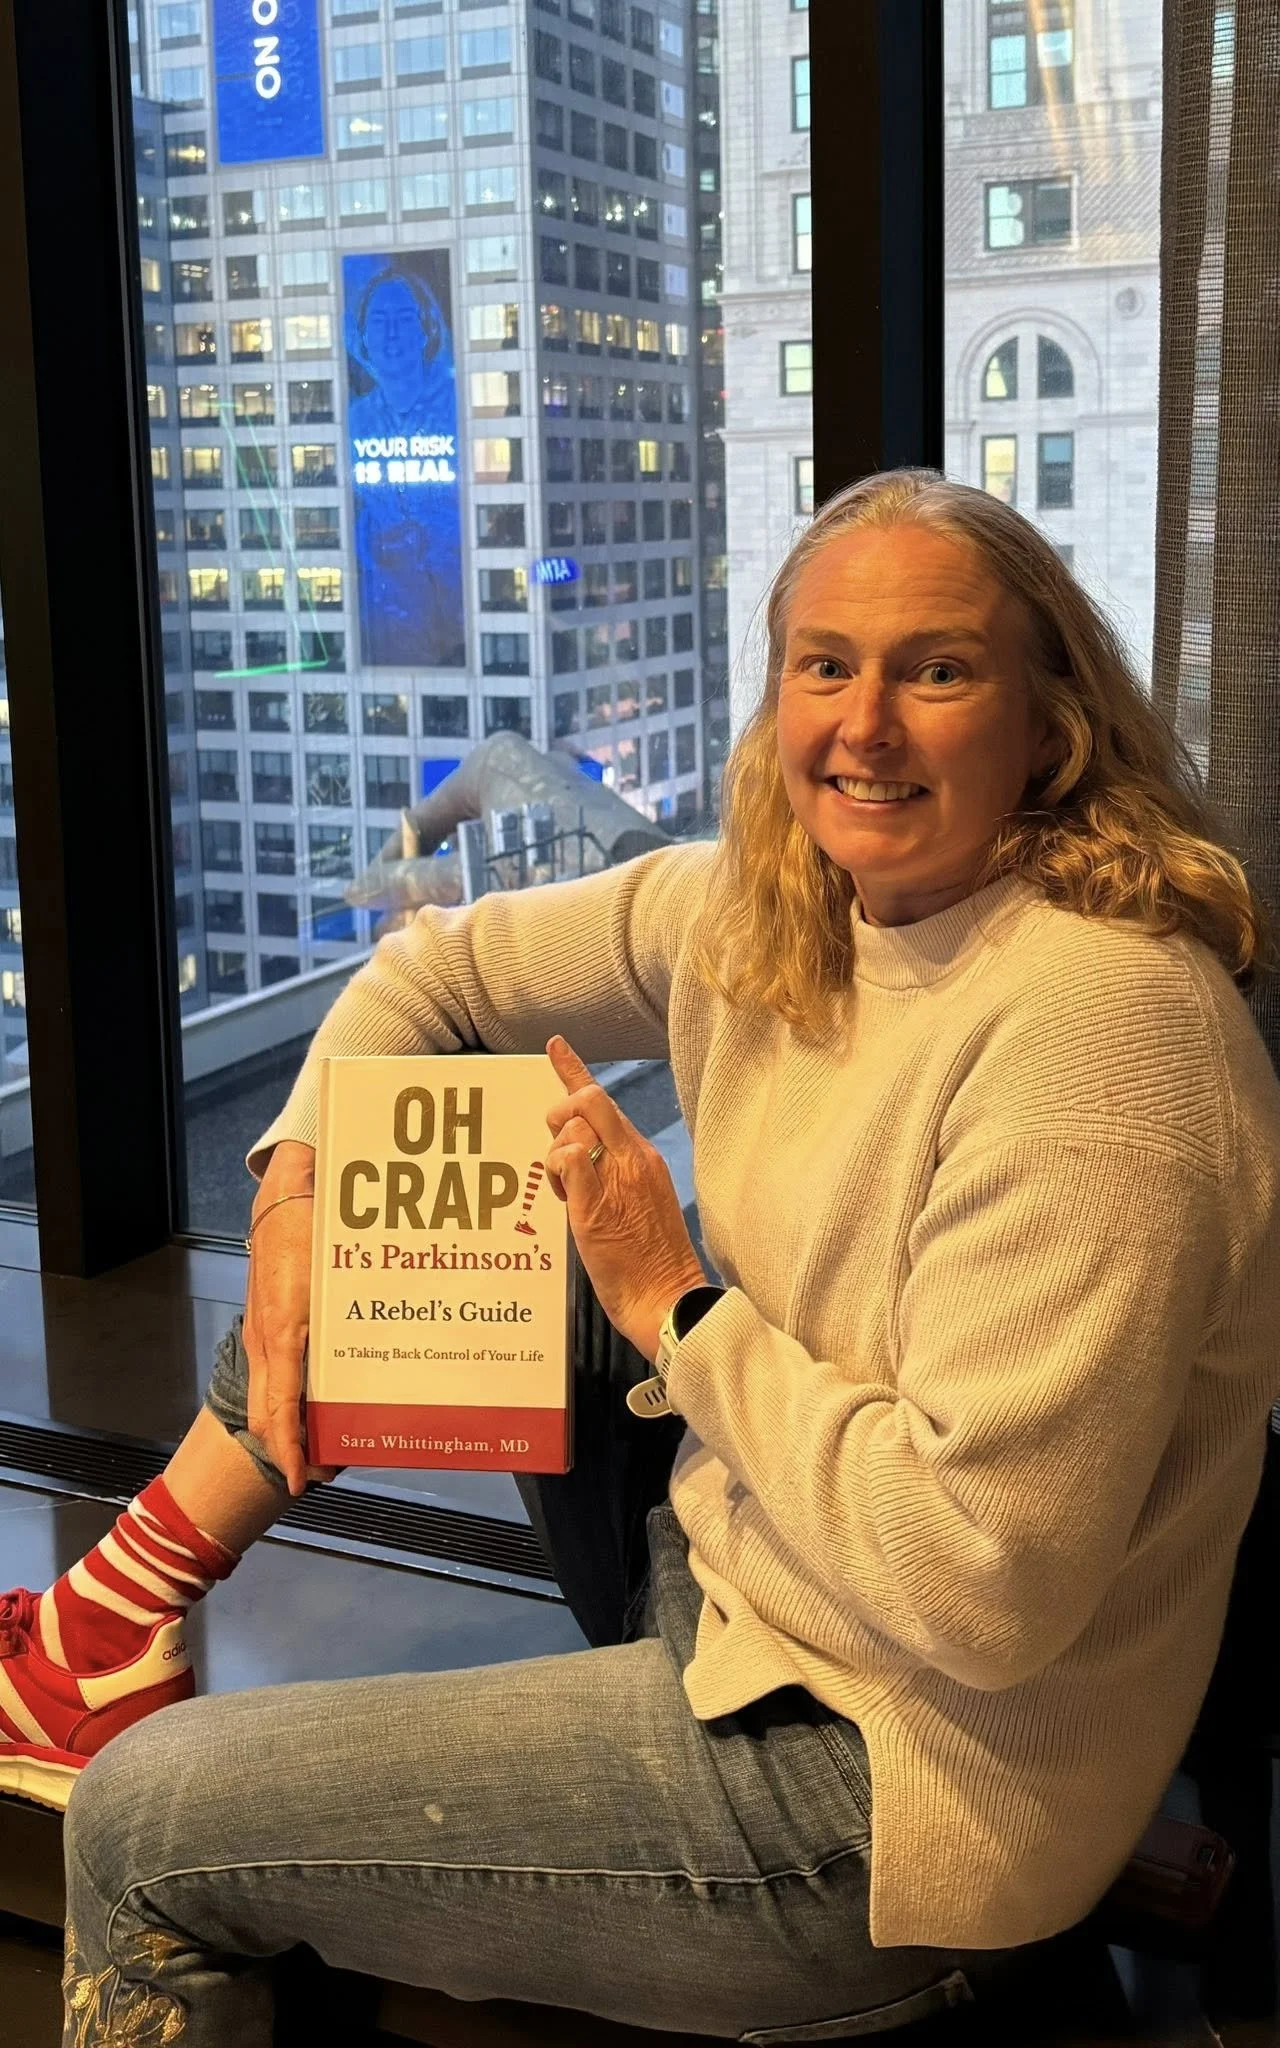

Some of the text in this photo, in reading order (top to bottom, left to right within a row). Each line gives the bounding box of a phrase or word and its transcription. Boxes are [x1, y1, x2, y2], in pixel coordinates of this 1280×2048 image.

[353, 435, 456, 457] YOUR RISK
[355, 458, 456, 484] IS REAL
[393, 1086, 483, 1155] OH
[331, 1243, 553, 1272] It's Parkinson's
[345, 1299, 533, 1324] A Rebel's Guide
[333, 1347, 545, 1363] to Taking Back Control of Your Life
[340, 1434, 530, 1455] Sara Whittingham, MD
